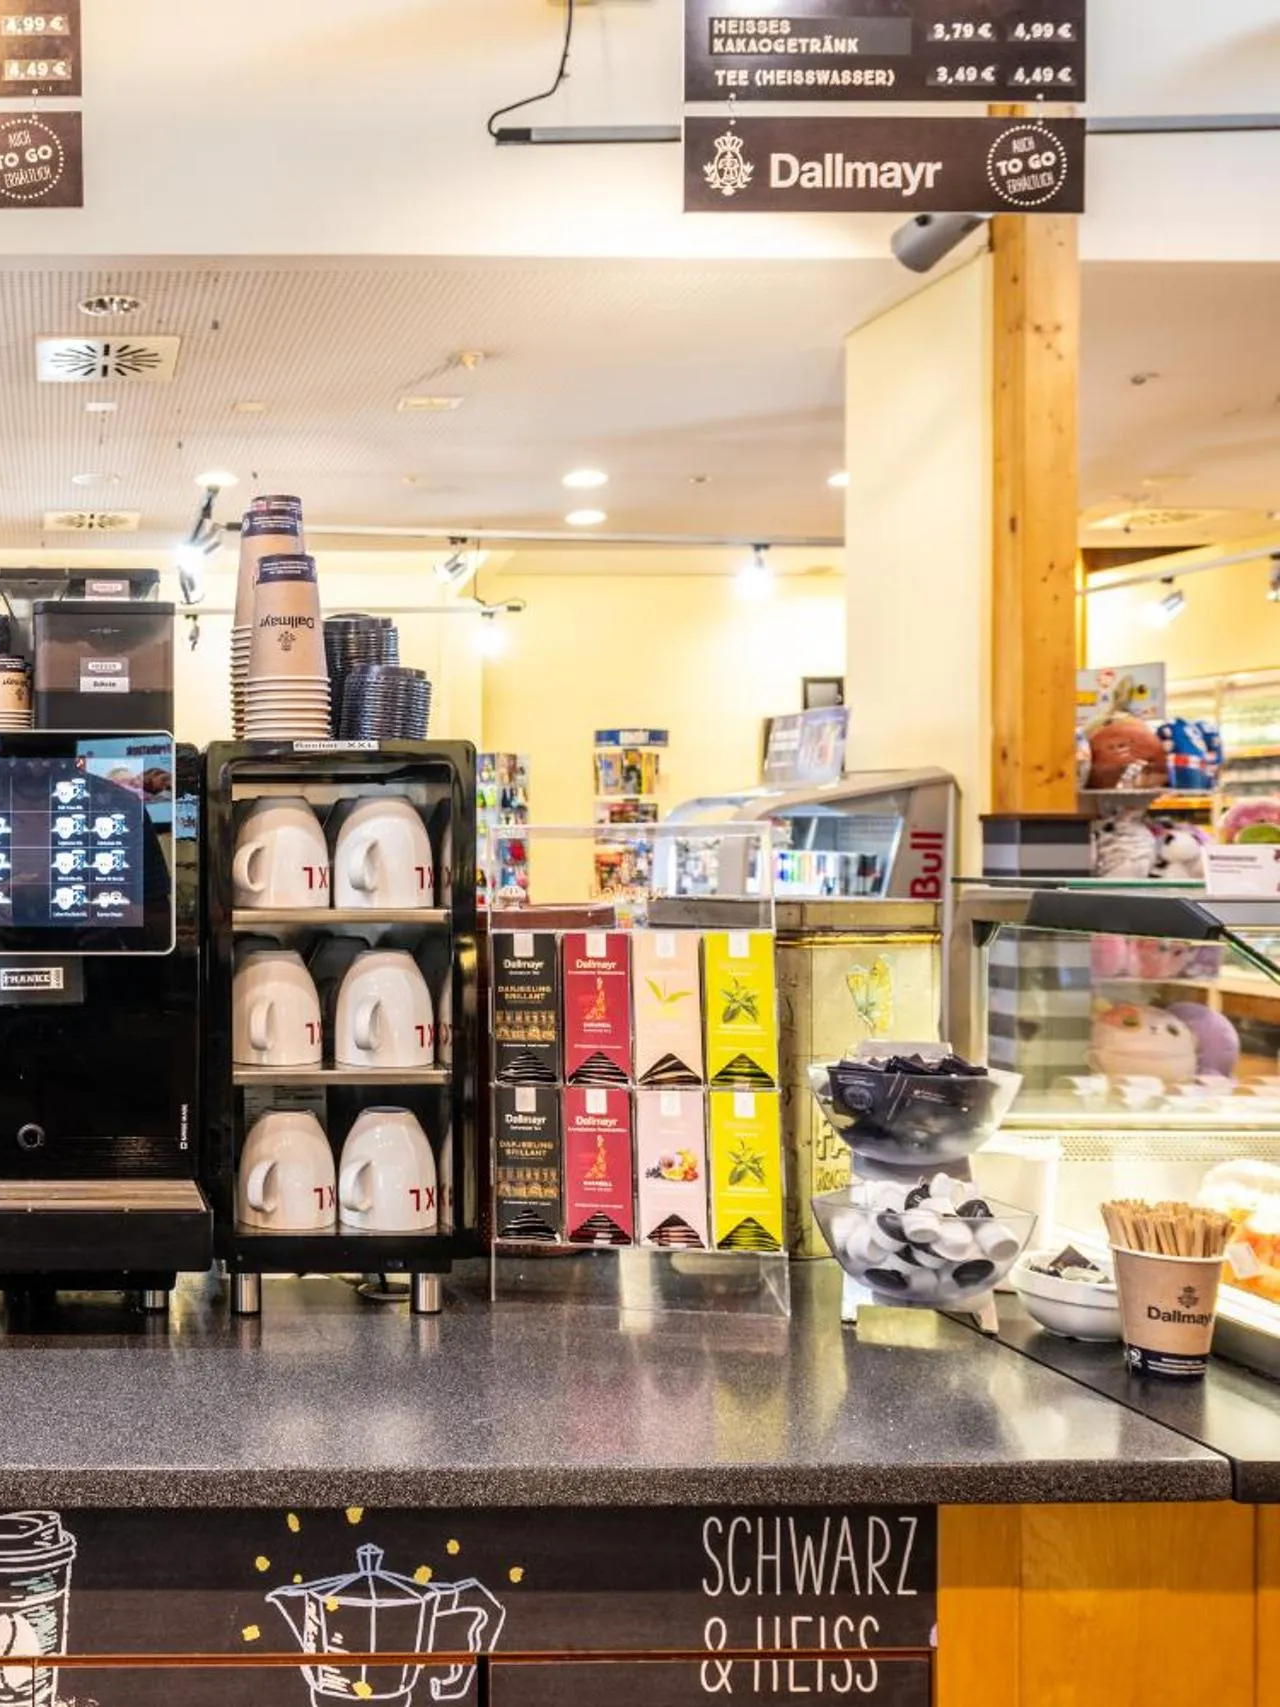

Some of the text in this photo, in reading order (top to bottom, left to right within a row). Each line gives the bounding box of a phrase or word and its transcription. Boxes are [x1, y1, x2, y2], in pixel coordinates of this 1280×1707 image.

[712, 19, 791, 35] HEISSES
[713, 35, 859, 53] KAKAOGETRÄNK
[714, 69, 895, 87] TEE (HEISSWASSER)
[25, 144, 52, 163] GO
[996, 151, 1056, 176] TO GO
[770, 153, 942, 197] Dallmayr
[910, 832, 943, 898] Bull
[1146, 1306, 1213, 1328] Dallmay
[702, 1516, 919, 1597] SCHWARZ
[700, 1616, 881, 1693] & HEISS
